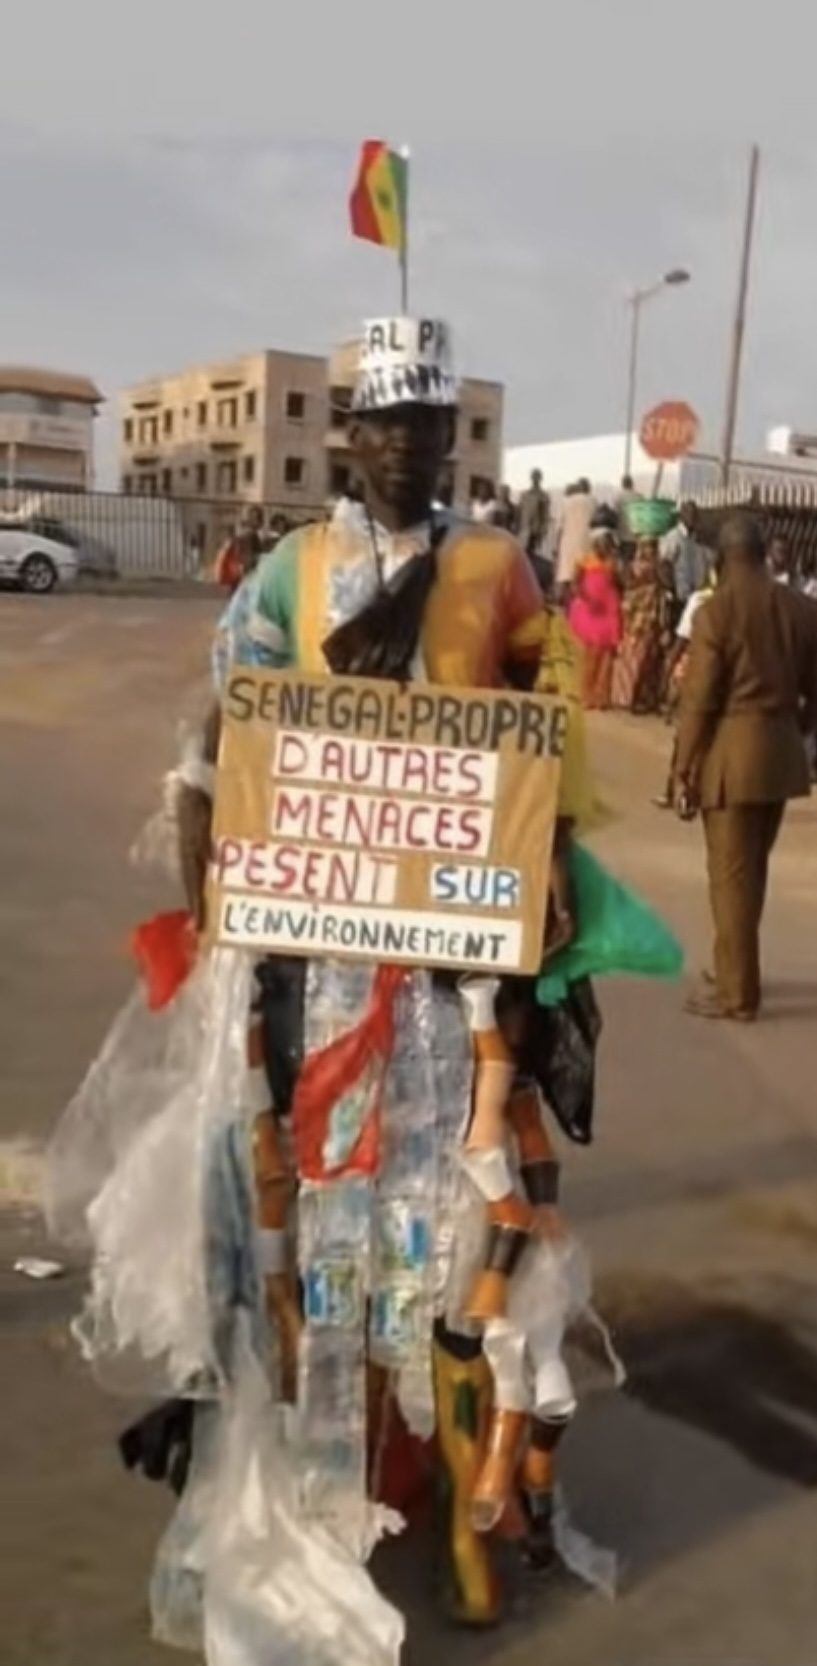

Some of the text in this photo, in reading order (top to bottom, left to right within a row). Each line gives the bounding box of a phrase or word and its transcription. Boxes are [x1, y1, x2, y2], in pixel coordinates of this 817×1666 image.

[643, 416, 695, 442] STOP
[278, 732, 483, 797] D'AUTRES
[275, 791, 481, 850] MENACES
[435, 864, 518, 907] SUR
